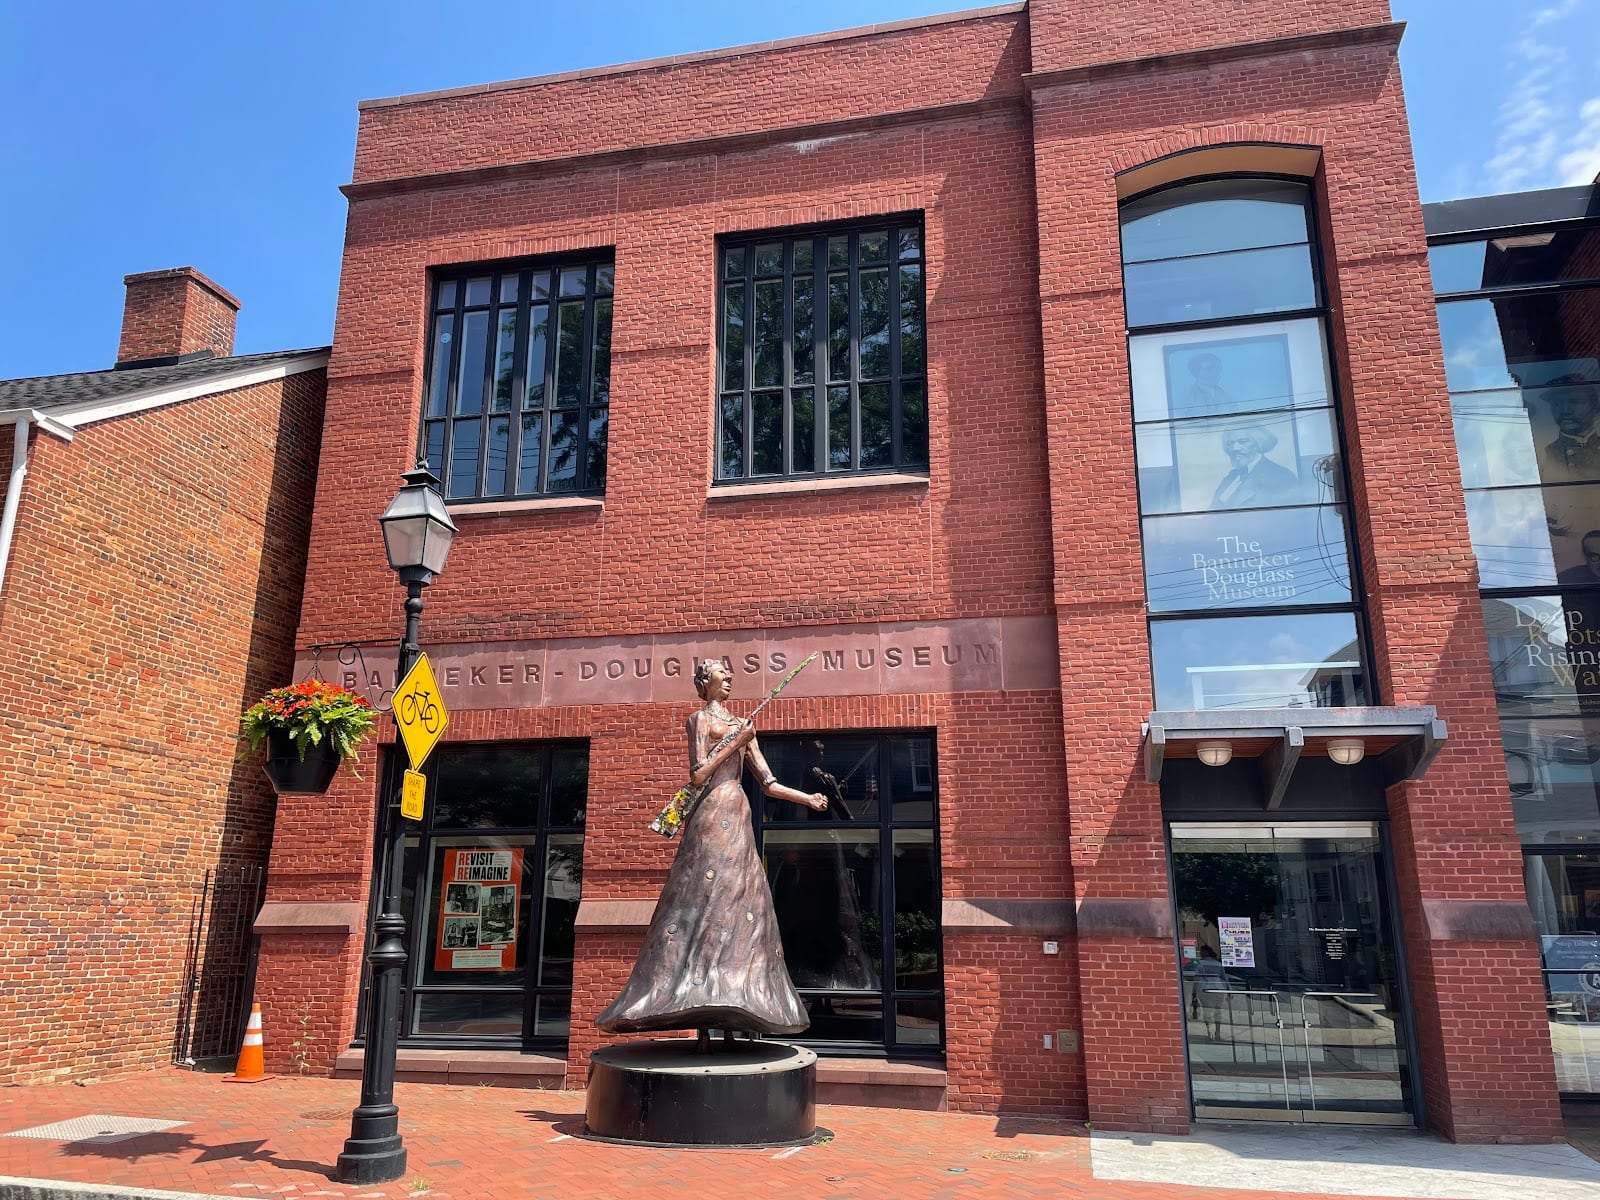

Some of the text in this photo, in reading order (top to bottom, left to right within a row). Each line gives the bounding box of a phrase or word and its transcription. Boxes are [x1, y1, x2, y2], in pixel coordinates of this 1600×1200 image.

[1217, 536, 1260, 554] The
[1192, 550, 1301, 571] Banneker-
[1202, 565, 1294, 588] Douglass
[1209, 584, 1296, 601] Museum
[1515, 604, 1583, 631] Dep
[822, 643, 998, 671] MUSEUM
[1523, 643, 1600, 669] Risin
[458, 852, 494, 867] REVISIT
[457, 866, 509, 881] REIMAGINE
